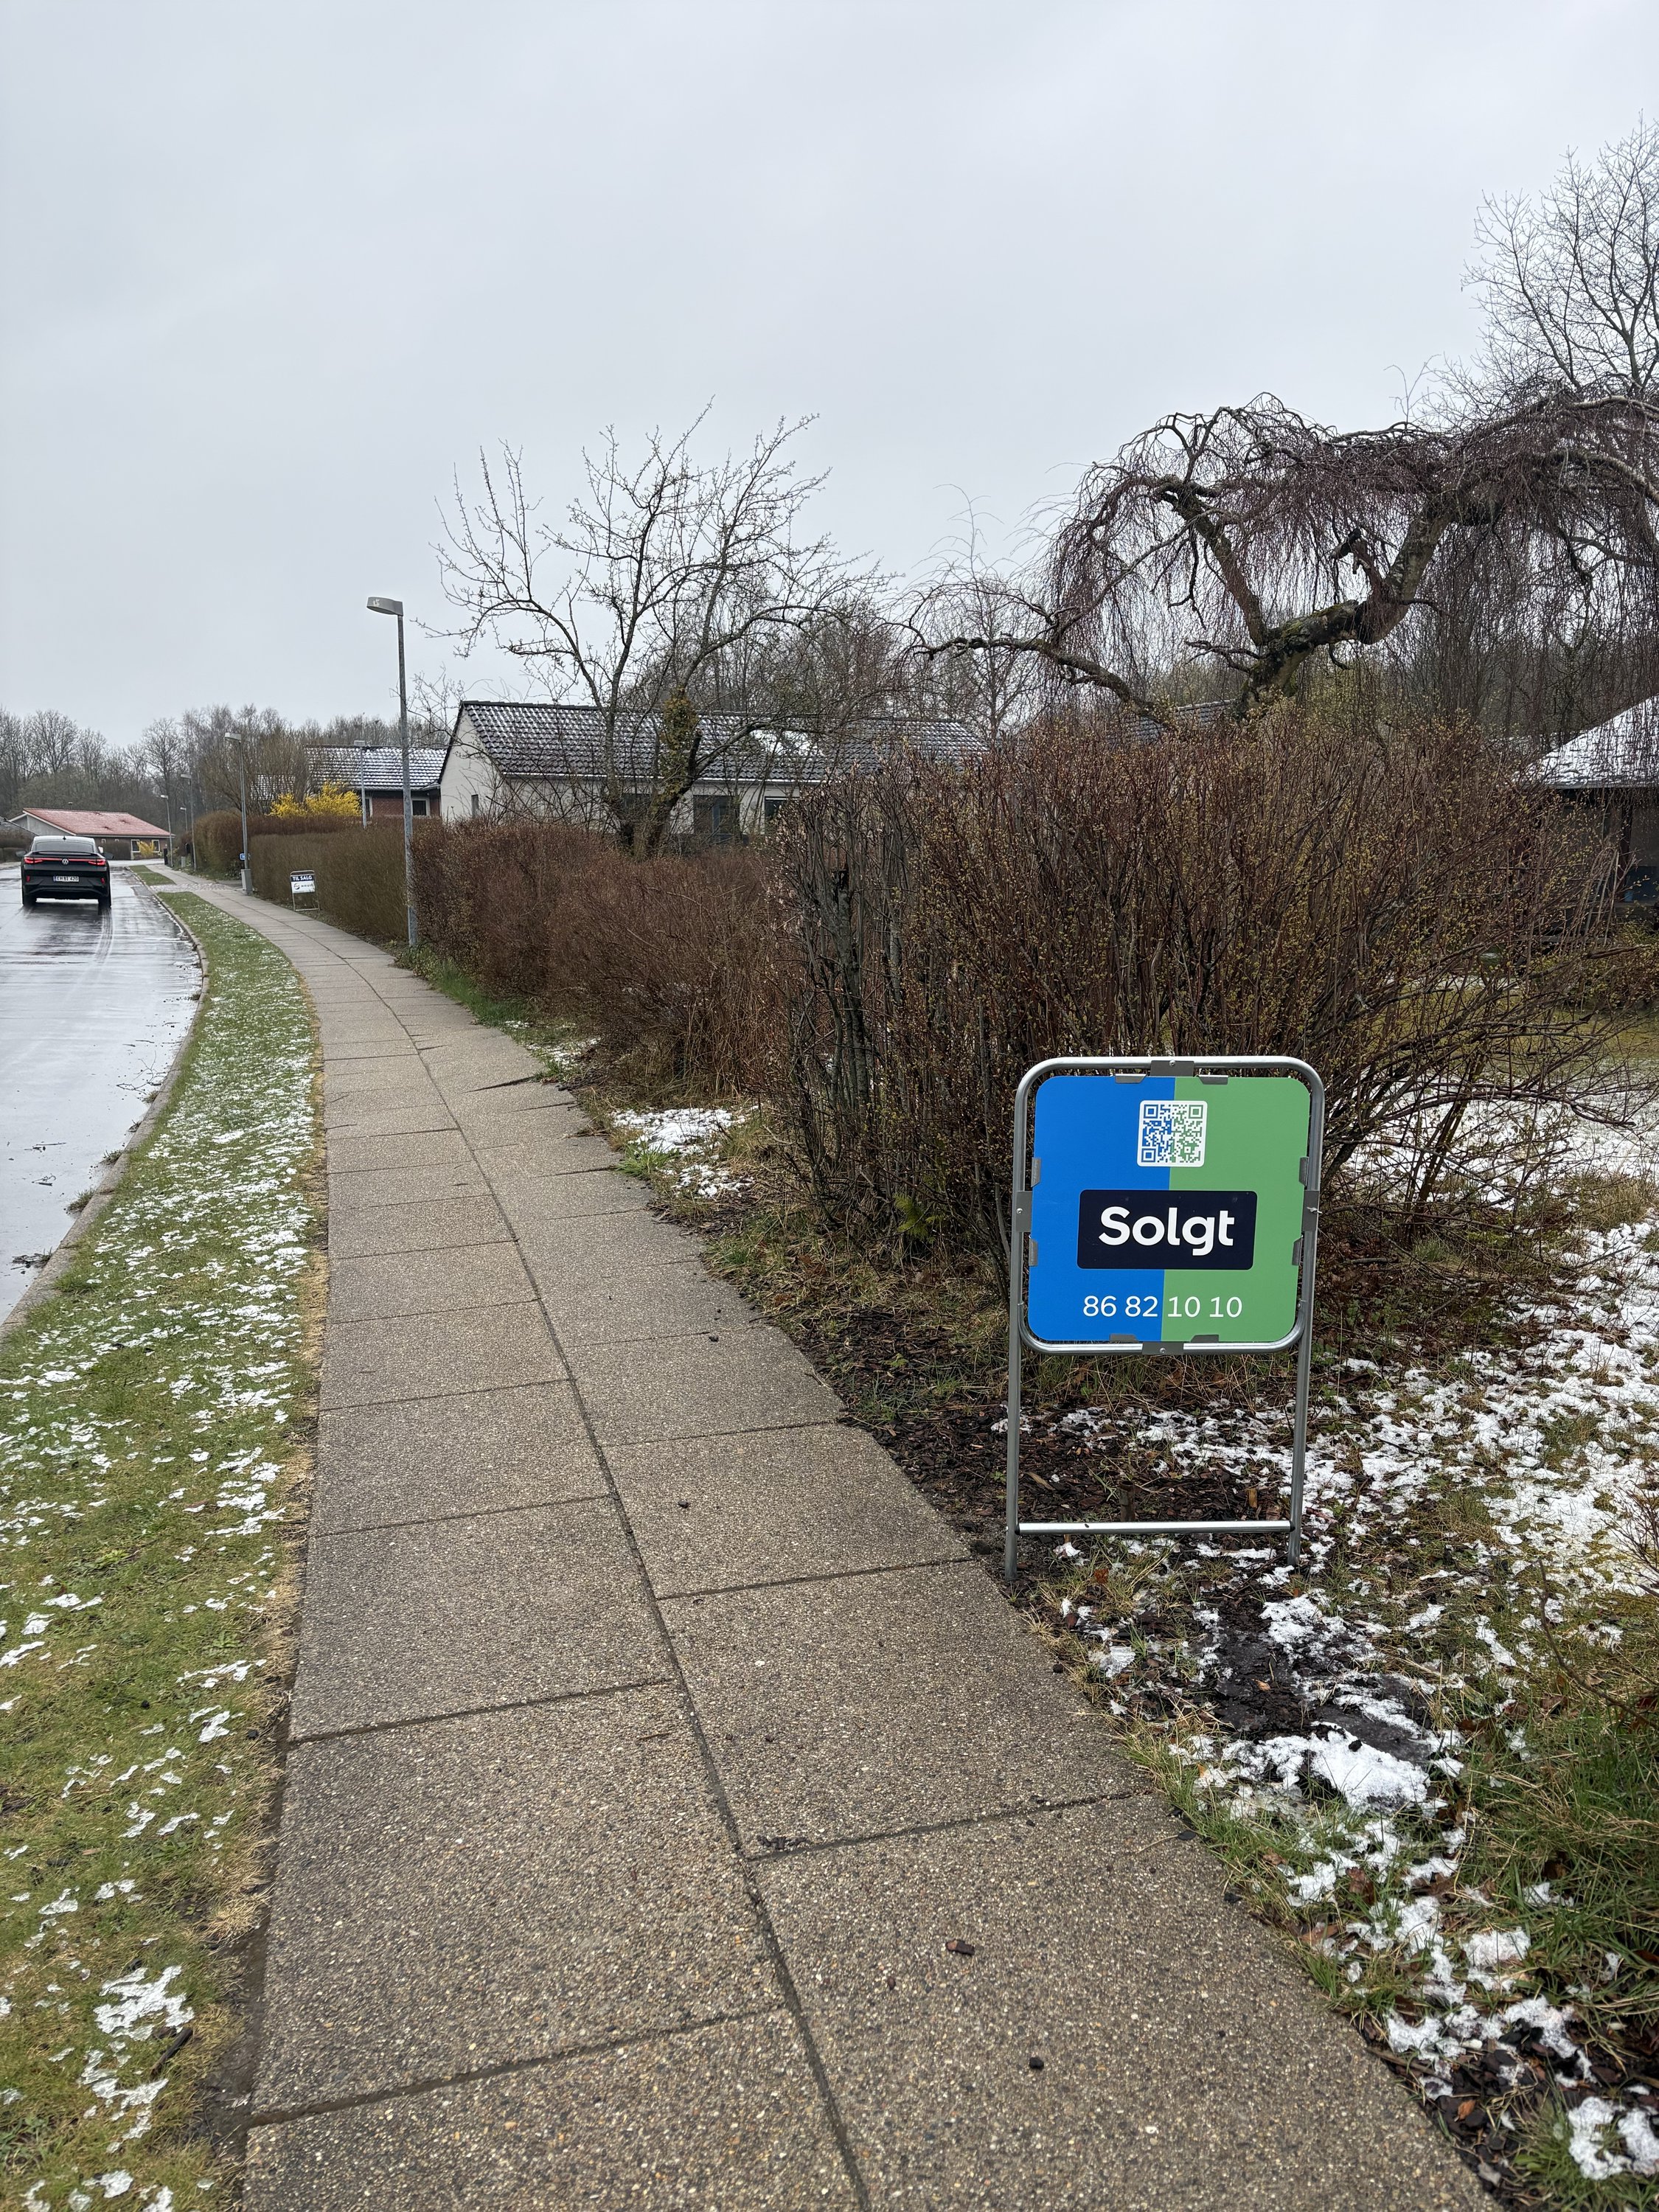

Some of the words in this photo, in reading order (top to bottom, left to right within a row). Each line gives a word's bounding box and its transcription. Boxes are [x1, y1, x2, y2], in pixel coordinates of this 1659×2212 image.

[1099, 1206, 1235, 1256] Solgt
[1082, 1295, 1116, 1318] 86
[1124, 1295, 1158, 1318] 82
[1167, 1296, 1200, 1318] 10
[1209, 1296, 1242, 1318] 10
